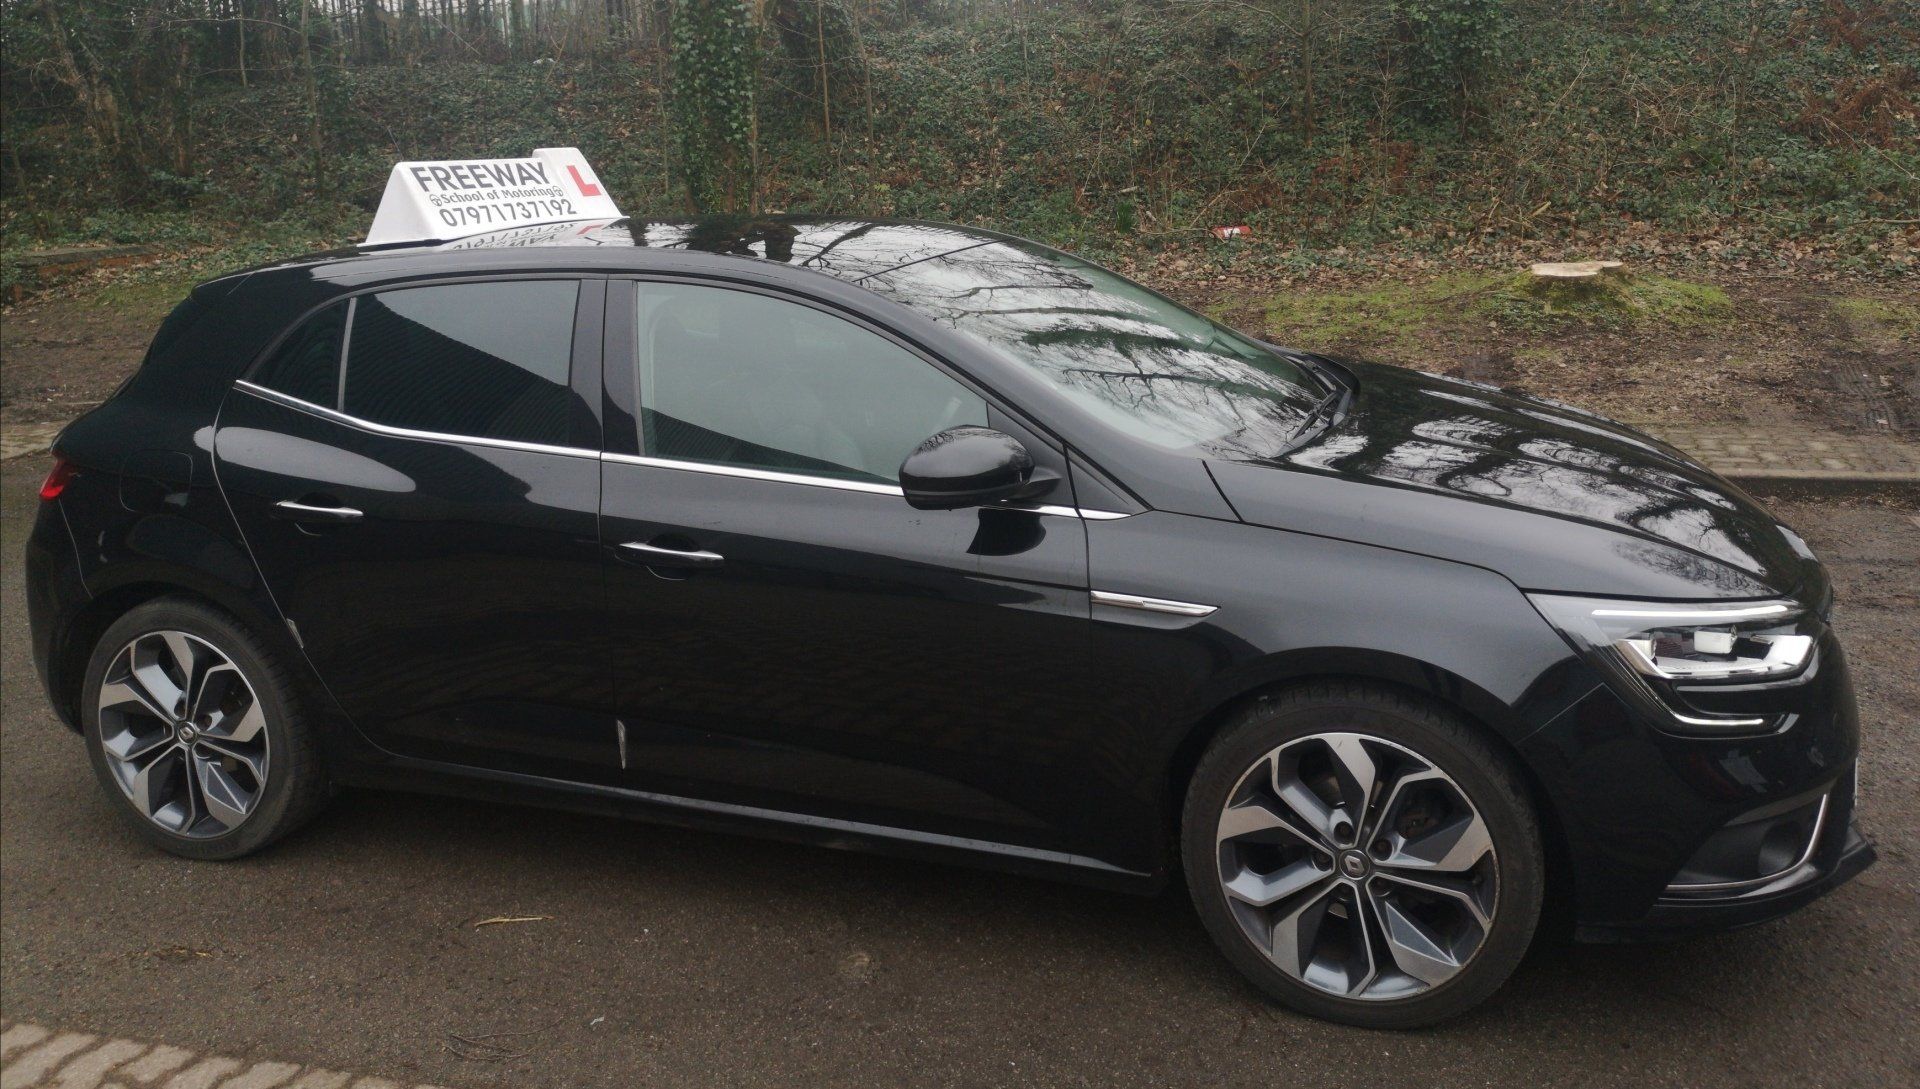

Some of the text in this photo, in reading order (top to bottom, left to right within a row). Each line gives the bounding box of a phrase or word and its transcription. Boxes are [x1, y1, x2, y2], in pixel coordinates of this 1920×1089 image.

[410, 162, 550, 192] FREEWAY
[566, 165, 602, 197] L
[440, 186, 556, 204] School of Motoring
[439, 198, 578, 227] 07971737192
